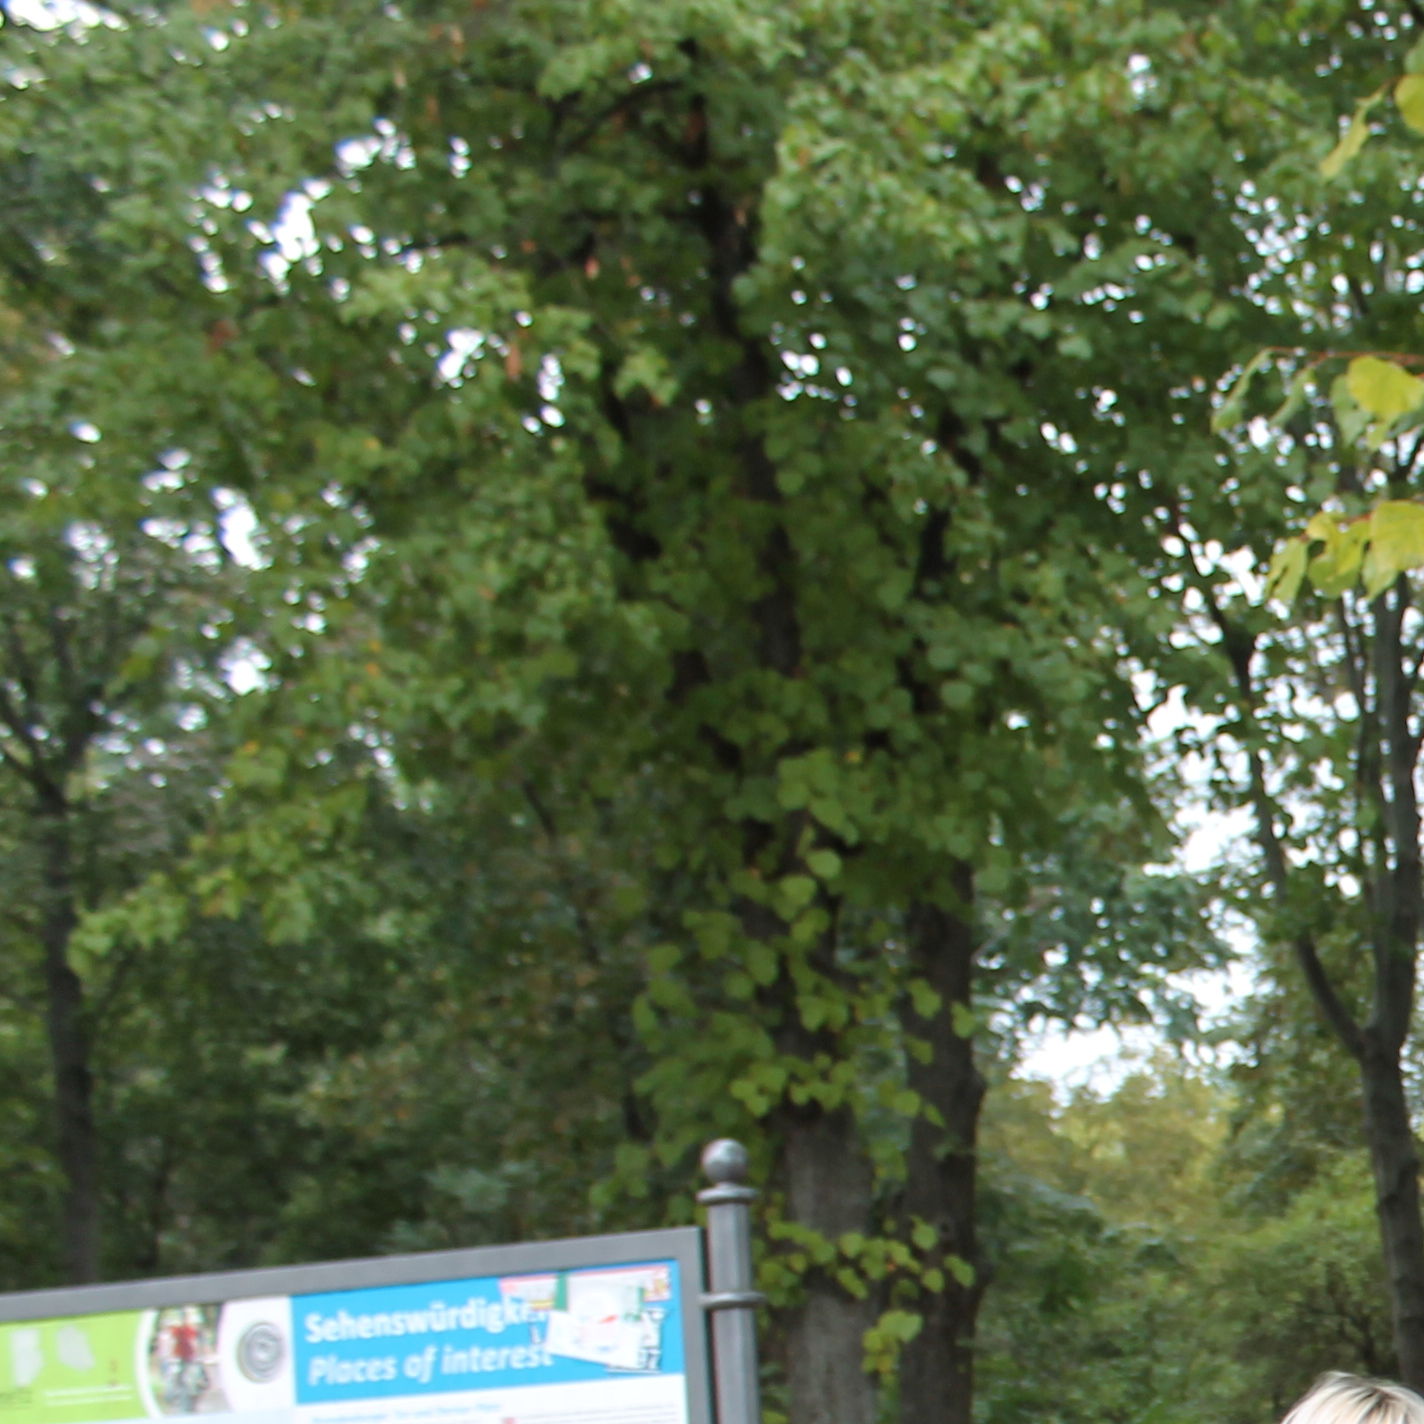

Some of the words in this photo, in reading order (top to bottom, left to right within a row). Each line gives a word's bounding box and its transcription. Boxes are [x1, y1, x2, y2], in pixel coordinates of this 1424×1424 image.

[308, 1355, 397, 1385] Places
[403, 1346, 436, 1384] of
[441, 1343, 553, 1376] interest
